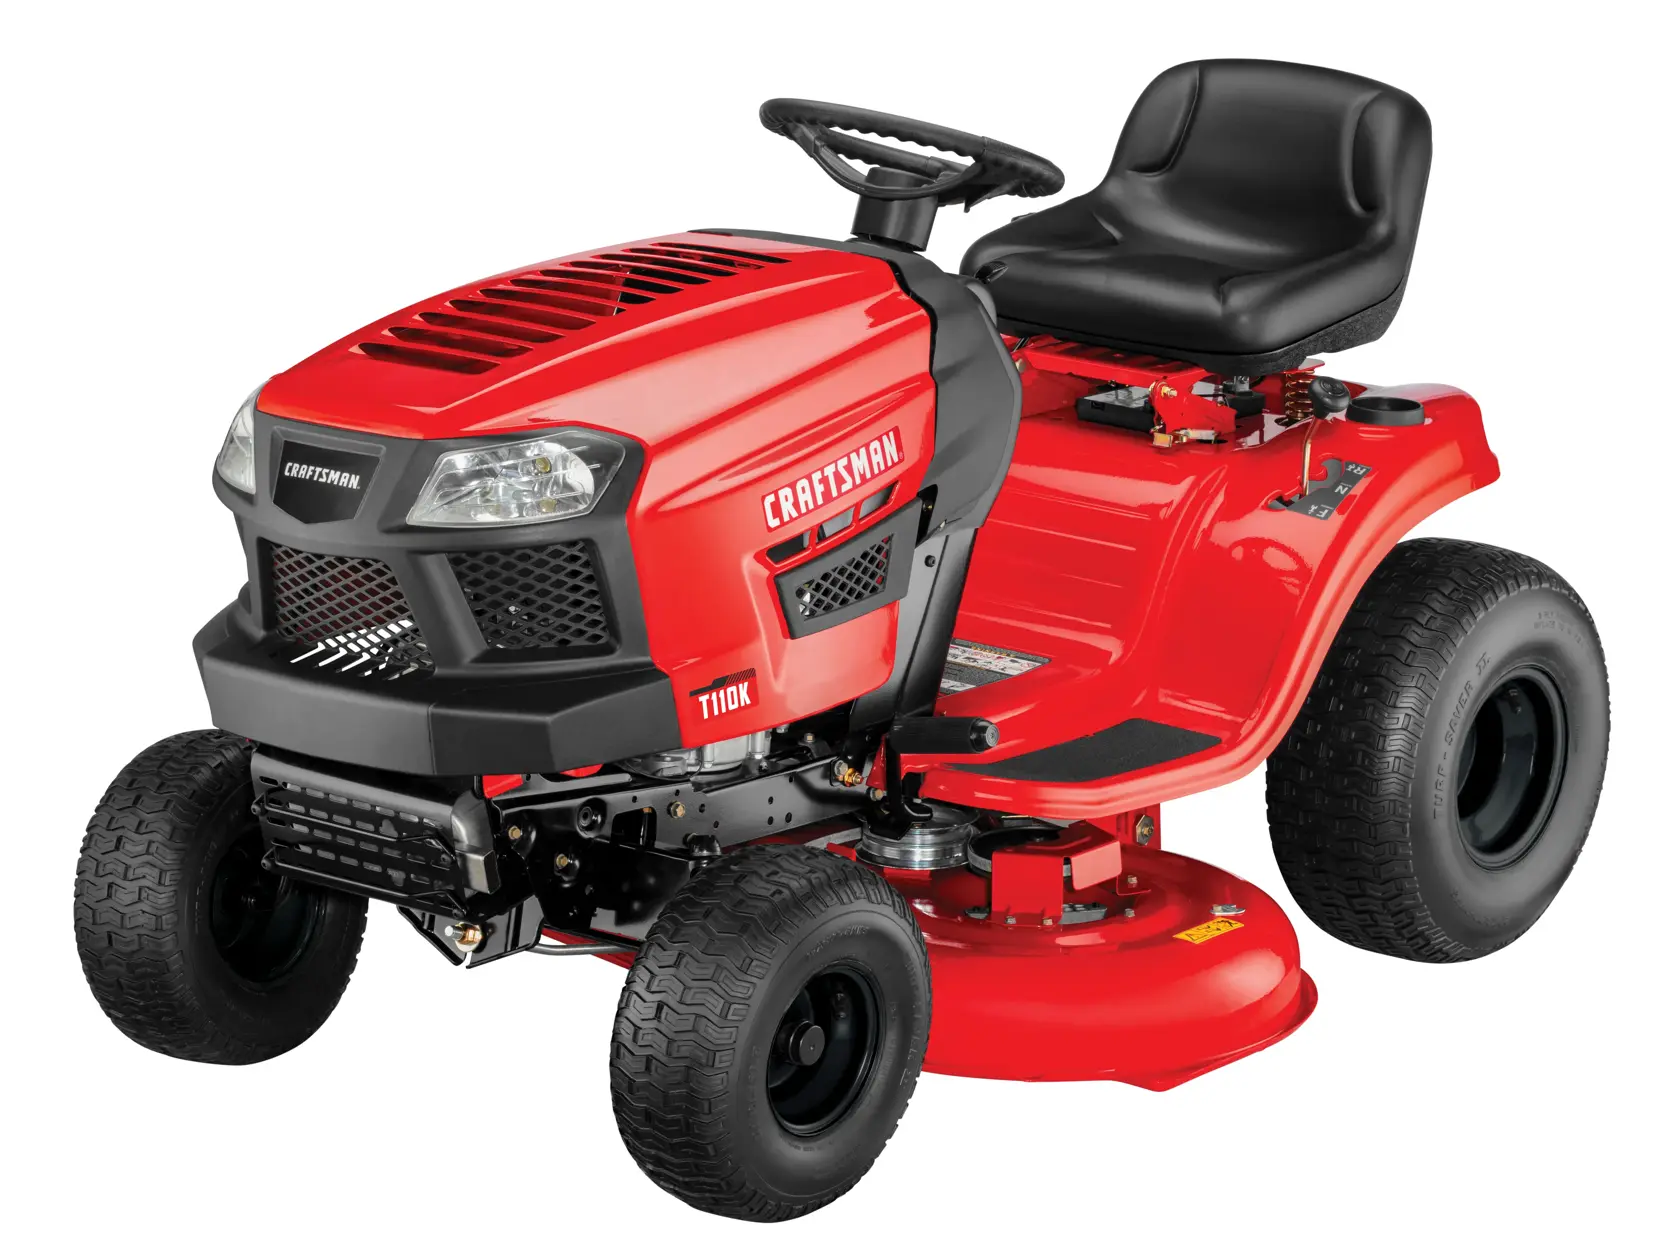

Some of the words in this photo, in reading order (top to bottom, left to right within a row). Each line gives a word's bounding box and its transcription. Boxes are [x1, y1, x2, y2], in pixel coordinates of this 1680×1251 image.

[284, 461, 360, 490] CRAFTSMAN
[763, 430, 900, 529] CRAFTSMAN
[1353, 466, 1367, 475] R
[1335, 485, 1349, 495] N
[1316, 509, 1329, 518] F
[698, 681, 752, 720] T110K
